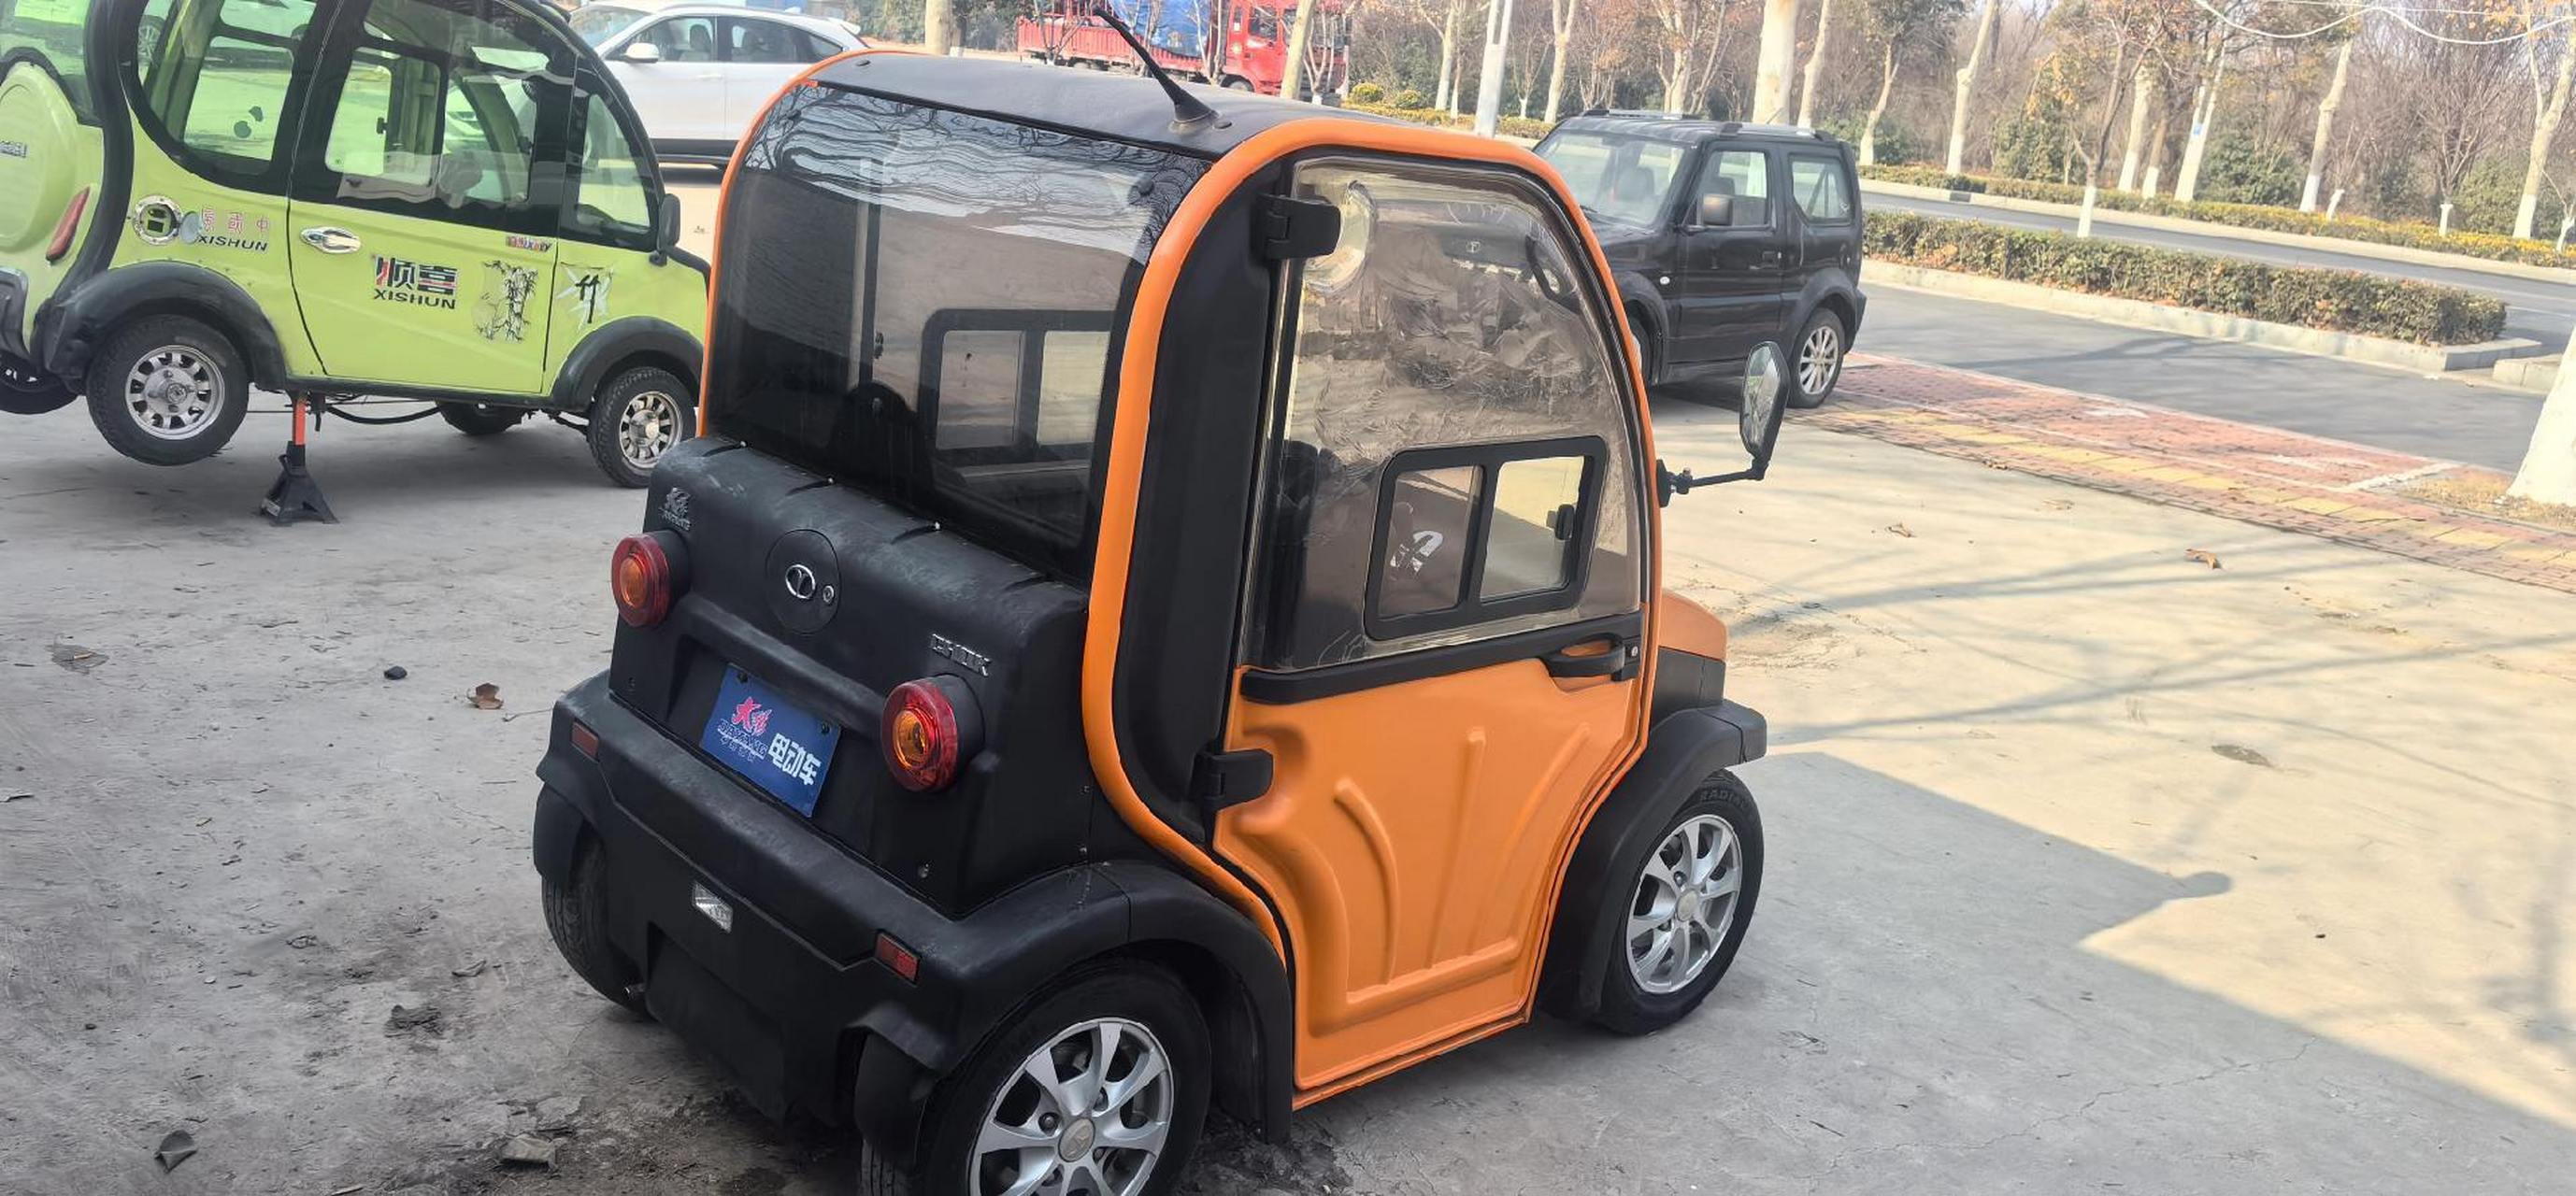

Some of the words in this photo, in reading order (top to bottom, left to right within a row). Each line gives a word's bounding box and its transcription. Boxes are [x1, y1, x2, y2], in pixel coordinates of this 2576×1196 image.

[195, 234, 268, 251] XISHUN
[372, 288, 457, 310] XISHUN
[767, 732, 823, 786] 电动车
